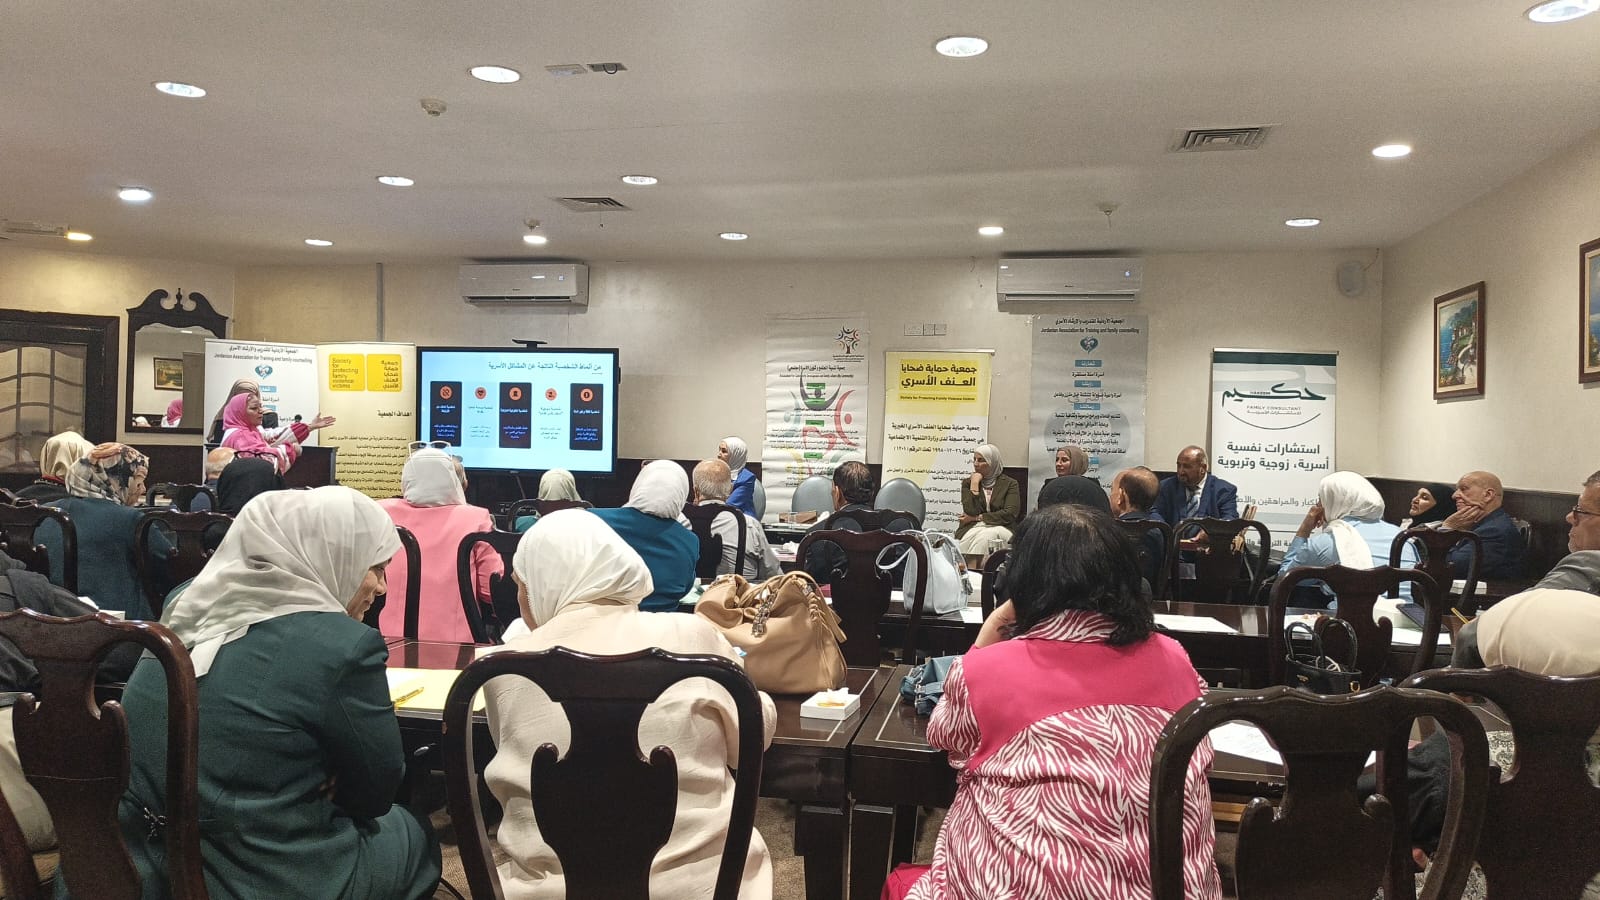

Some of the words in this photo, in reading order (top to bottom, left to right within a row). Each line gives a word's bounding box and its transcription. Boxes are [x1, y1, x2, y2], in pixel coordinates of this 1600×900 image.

[901, 364, 924, 373] ضحايا
[926, 364, 948, 374] حماية
[950, 364, 977, 374] جمعية
[901, 375, 936, 388] الأسري
[940, 377, 976, 386] العنف
[1222, 382, 1326, 408] حكيم
[378, 410, 396, 418] الجمعية
[1227, 442, 1261, 454] نفسية
[1265, 443, 1320, 456] استشارات
[1218, 456, 1256, 469] وتربوية
[1260, 458, 1289, 470] زوجية
[1294, 456, 1329, 471] أسرية،
[1258, 497, 1299, 506] والمراهقين
